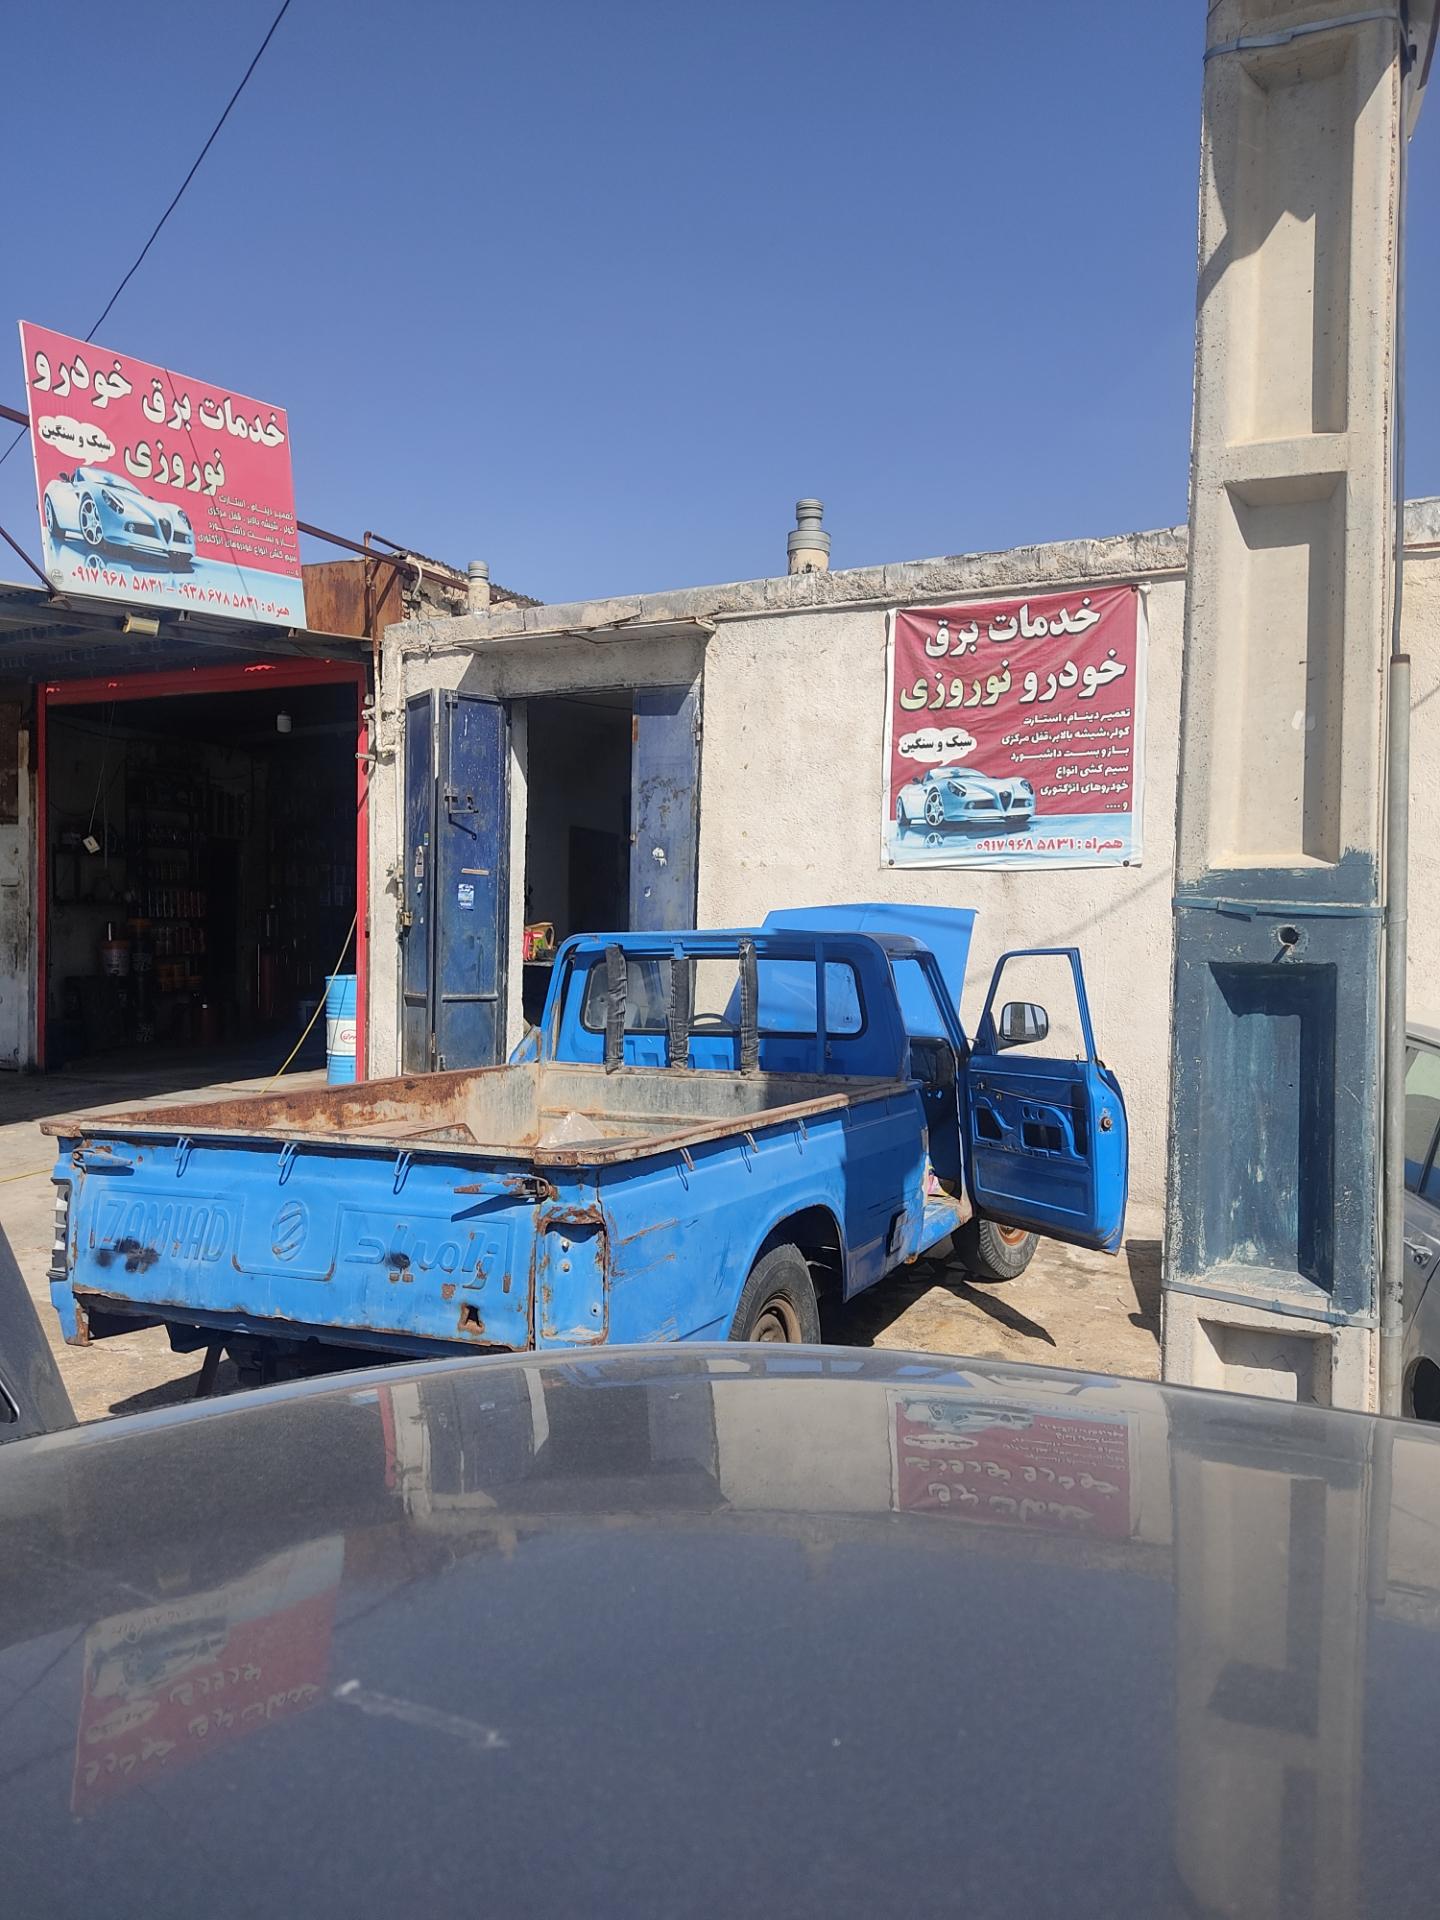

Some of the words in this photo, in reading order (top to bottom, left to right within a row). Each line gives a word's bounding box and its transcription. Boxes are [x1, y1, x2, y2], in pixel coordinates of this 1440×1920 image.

[33, 351, 132, 409] خودرو
[142, 379, 191, 431] برق
[199, 397, 285, 447] خدمات
[41, 425, 75, 442] سنگین
[86, 434, 111, 451] سبک
[124, 440, 225, 496] نوروزی
[989, 597, 1101, 642] خدمات
[925, 620, 979, 657] برق
[1020, 649, 1127, 703] خودرو
[900, 660, 1012, 709] نوروزی
[1023, 713, 1062, 726] استارت
[1100, 708, 1131, 722] تعمیر
[901, 738, 934, 754] سنگین
[938, 741, 943, 752] و
[946, 736, 973, 749] سبک
[1001, 734, 1030, 745] مرکزی
[1055, 765, 1078, 779] انواع
[1080, 763, 1103, 777] کشی
[1104, 765, 1129, 776] سیم
[1040, 782, 1079, 796] انژکتوری
[1080, 780, 1129, 794] خودروهای
[101, 1199, 230, 1262] ZAMYAD
